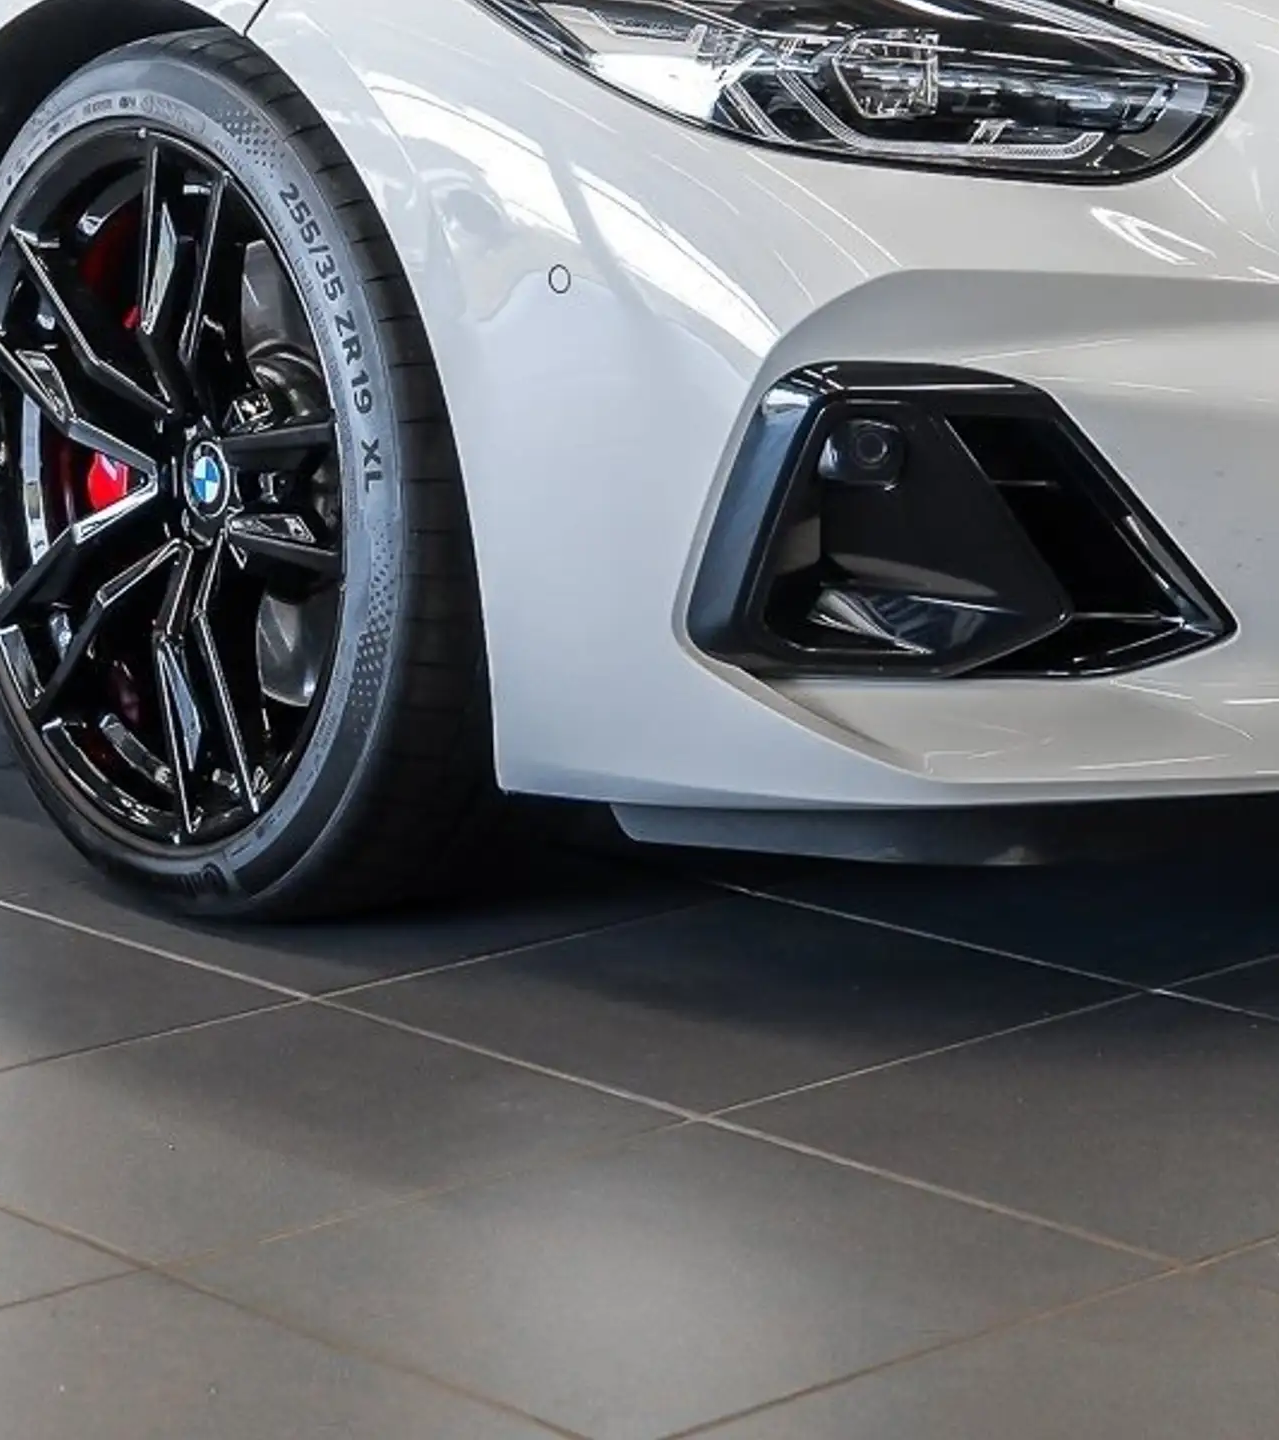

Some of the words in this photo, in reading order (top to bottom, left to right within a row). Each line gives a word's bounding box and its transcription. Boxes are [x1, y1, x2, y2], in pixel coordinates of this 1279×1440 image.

[279, 182, 346, 301] 255/35
[334, 310, 363, 365] ZR
[350, 374, 373, 415] 19
[360, 438, 384, 493] XL
